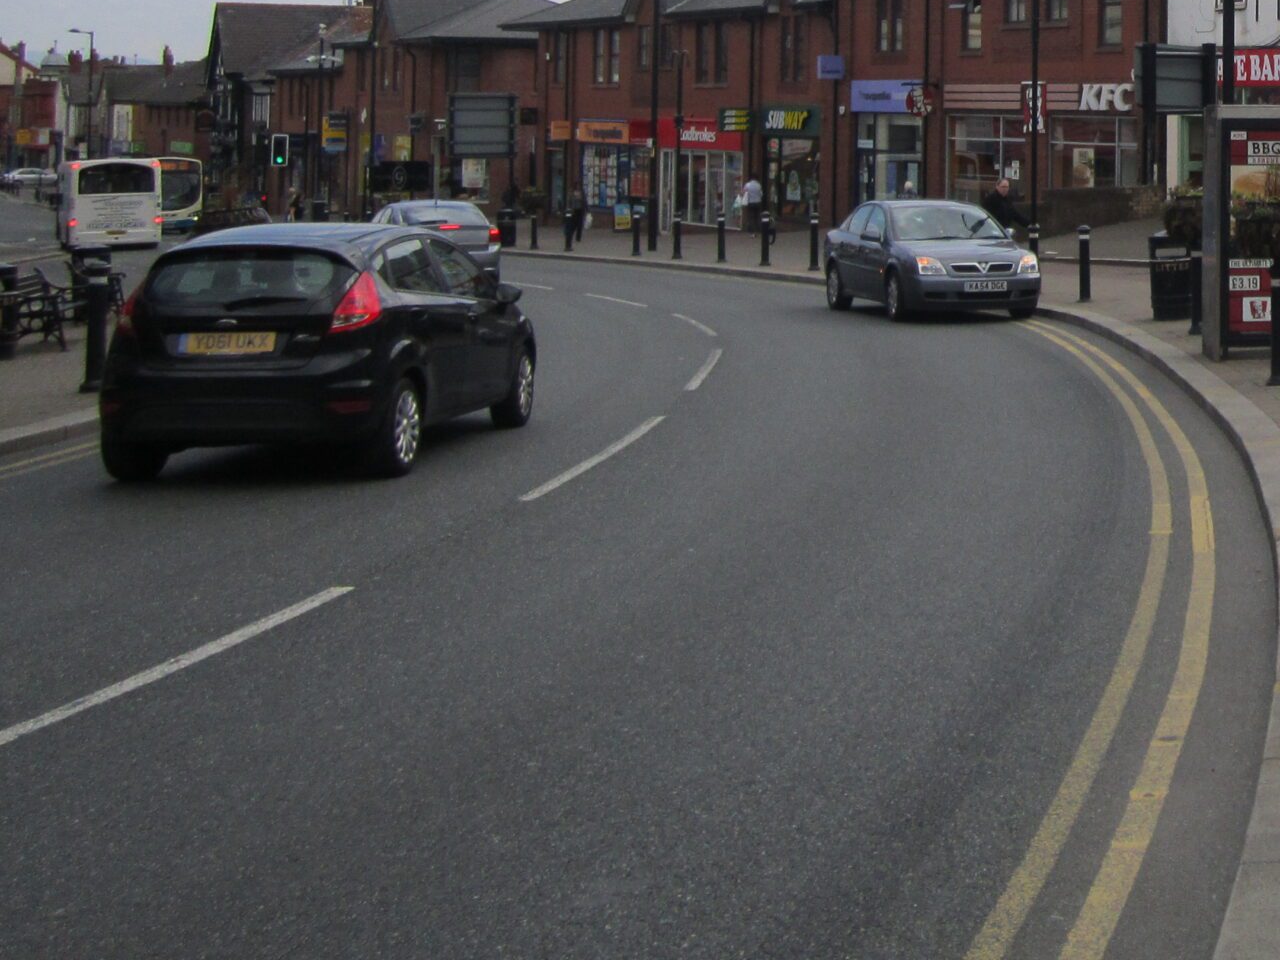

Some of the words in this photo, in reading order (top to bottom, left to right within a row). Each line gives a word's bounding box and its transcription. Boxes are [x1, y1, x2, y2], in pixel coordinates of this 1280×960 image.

[1079, 83, 1135, 112] KFC
[765, 110, 809, 130] SUBWAY
[1231, 277, 1258, 290] £3.19
